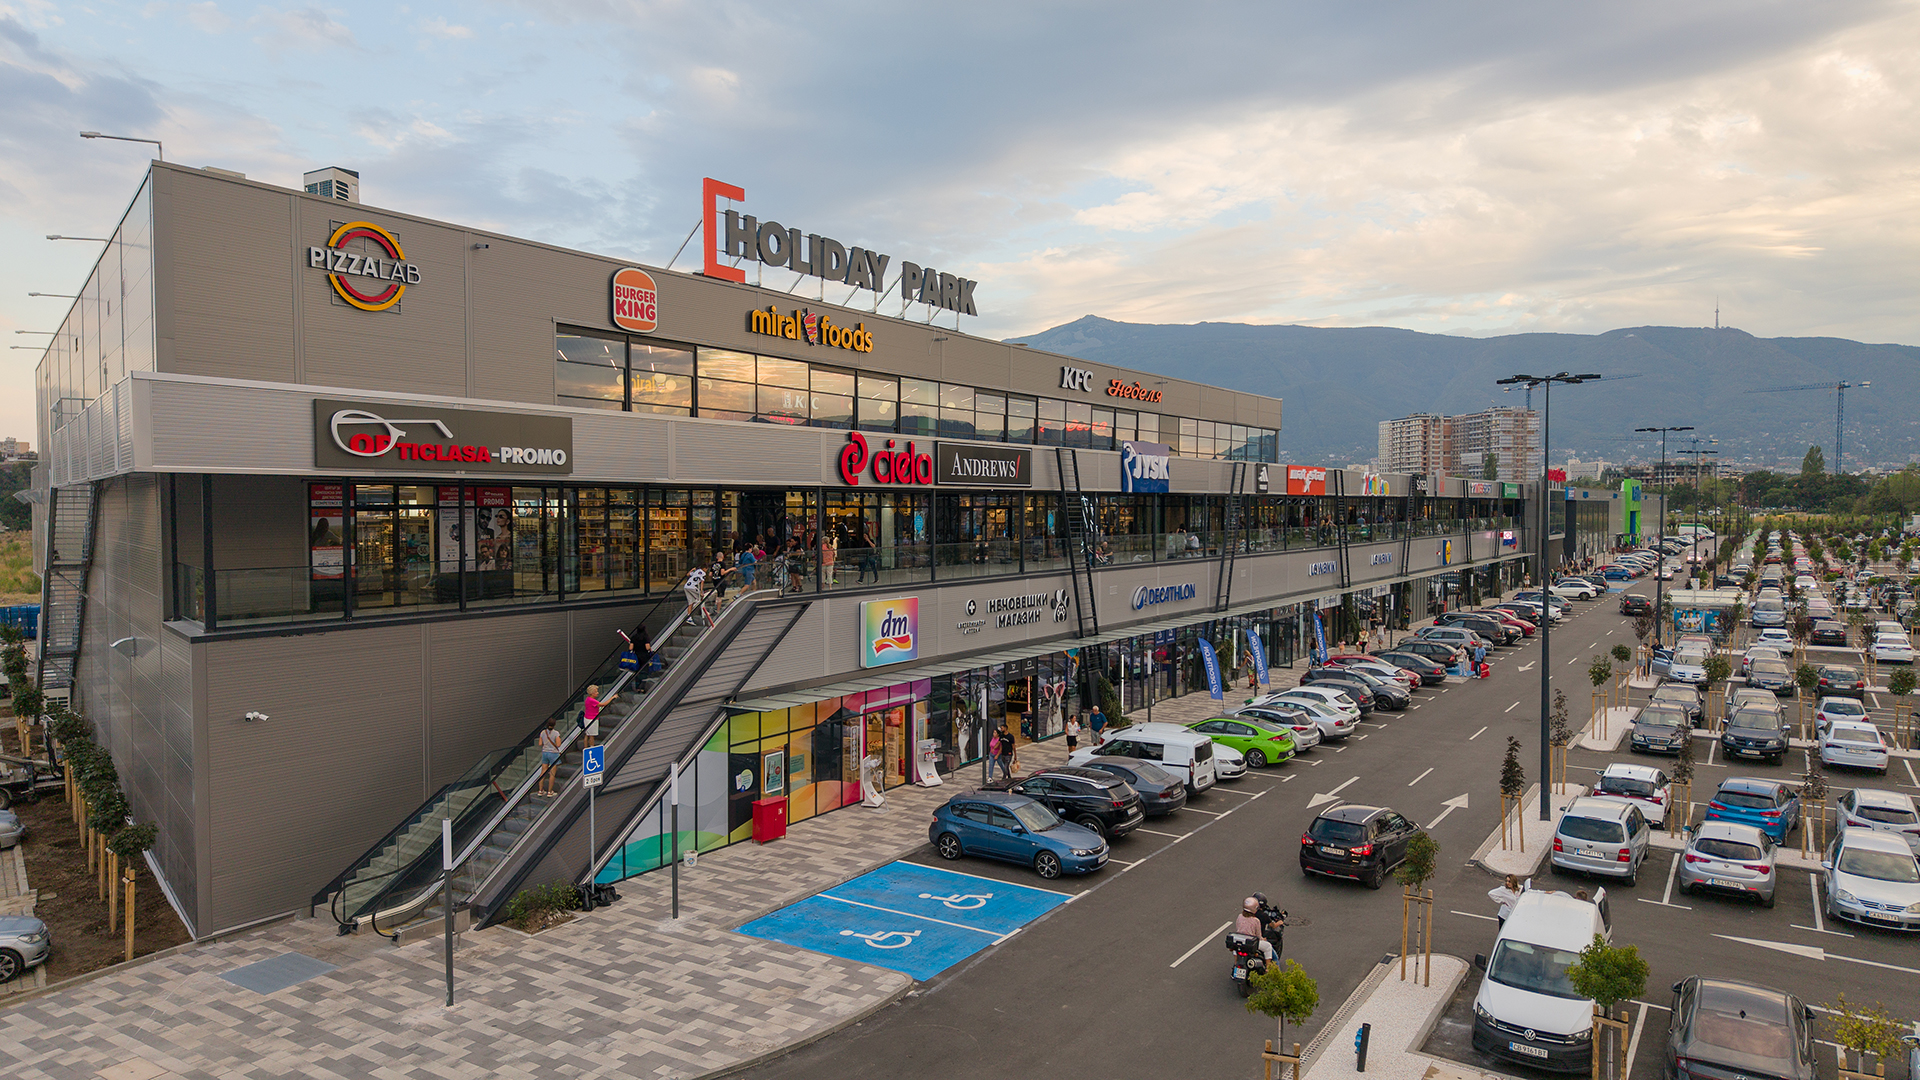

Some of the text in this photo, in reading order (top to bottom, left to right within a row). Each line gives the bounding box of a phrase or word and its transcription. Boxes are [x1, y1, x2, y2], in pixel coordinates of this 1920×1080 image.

[309, 246, 421, 284] PIZZALAB
[725, 209, 978, 317] HOLIDAY PARK
[615, 285, 656, 304] BURGER
[615, 298, 656, 321] KING
[751, 305, 873, 353] miral foods
[1061, 366, 1094, 392] KFC
[1107, 378, 1163, 403] Неделя
[873, 439, 932, 485] ciela
[1133, 454, 1170, 479] JYSK
[483, 497, 505, 505] PROMO
[987, 593, 1048, 613] НЕЧОВЕШКИ
[1149, 583, 1196, 604] DECATHLON
[880, 608, 908, 638] dm
[996, 609, 1041, 629] МАГАЗИН
[1203, 646, 1219, 684] DECATHLON
